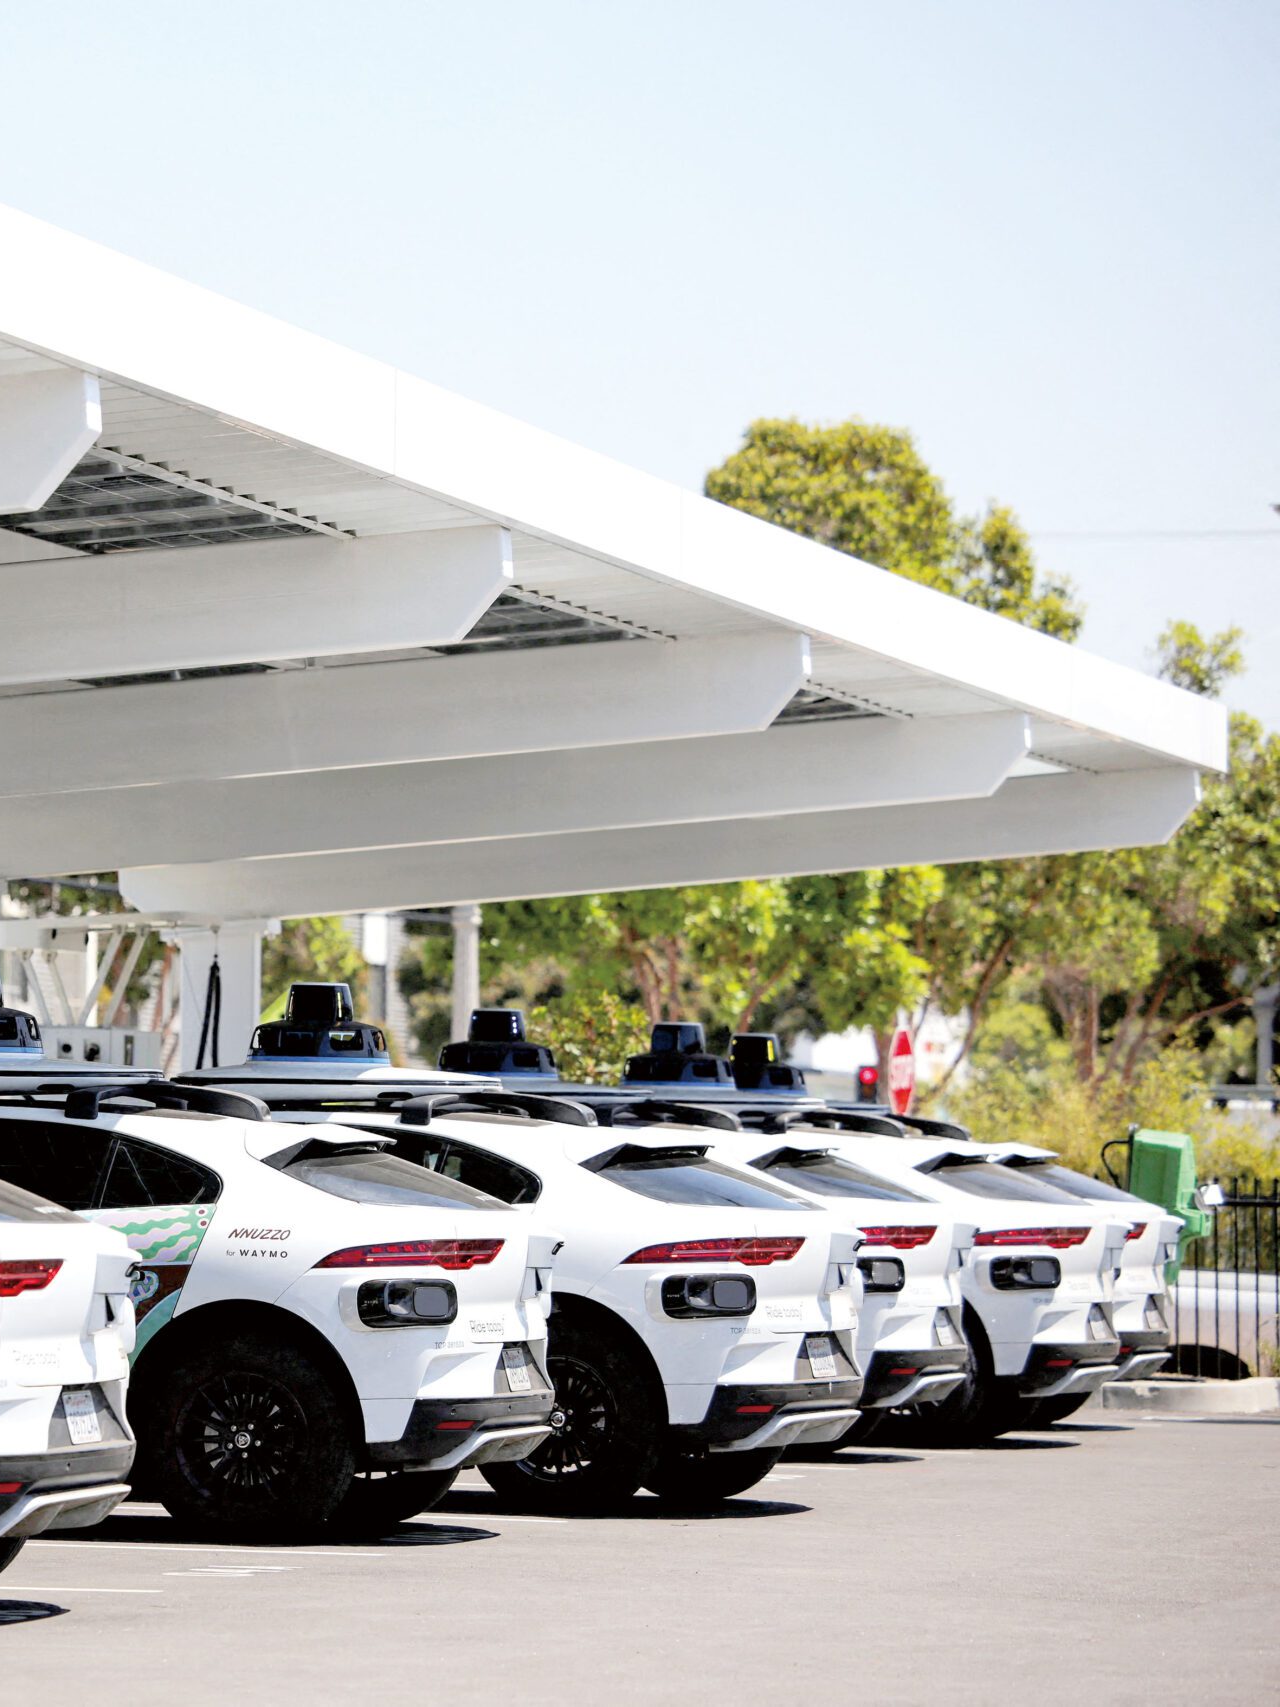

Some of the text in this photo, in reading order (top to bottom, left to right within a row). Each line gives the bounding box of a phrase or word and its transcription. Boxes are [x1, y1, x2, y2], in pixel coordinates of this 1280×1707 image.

[228, 1227, 291, 1241] NNUZZO
[226, 1248, 288, 1259] for WAYMO
